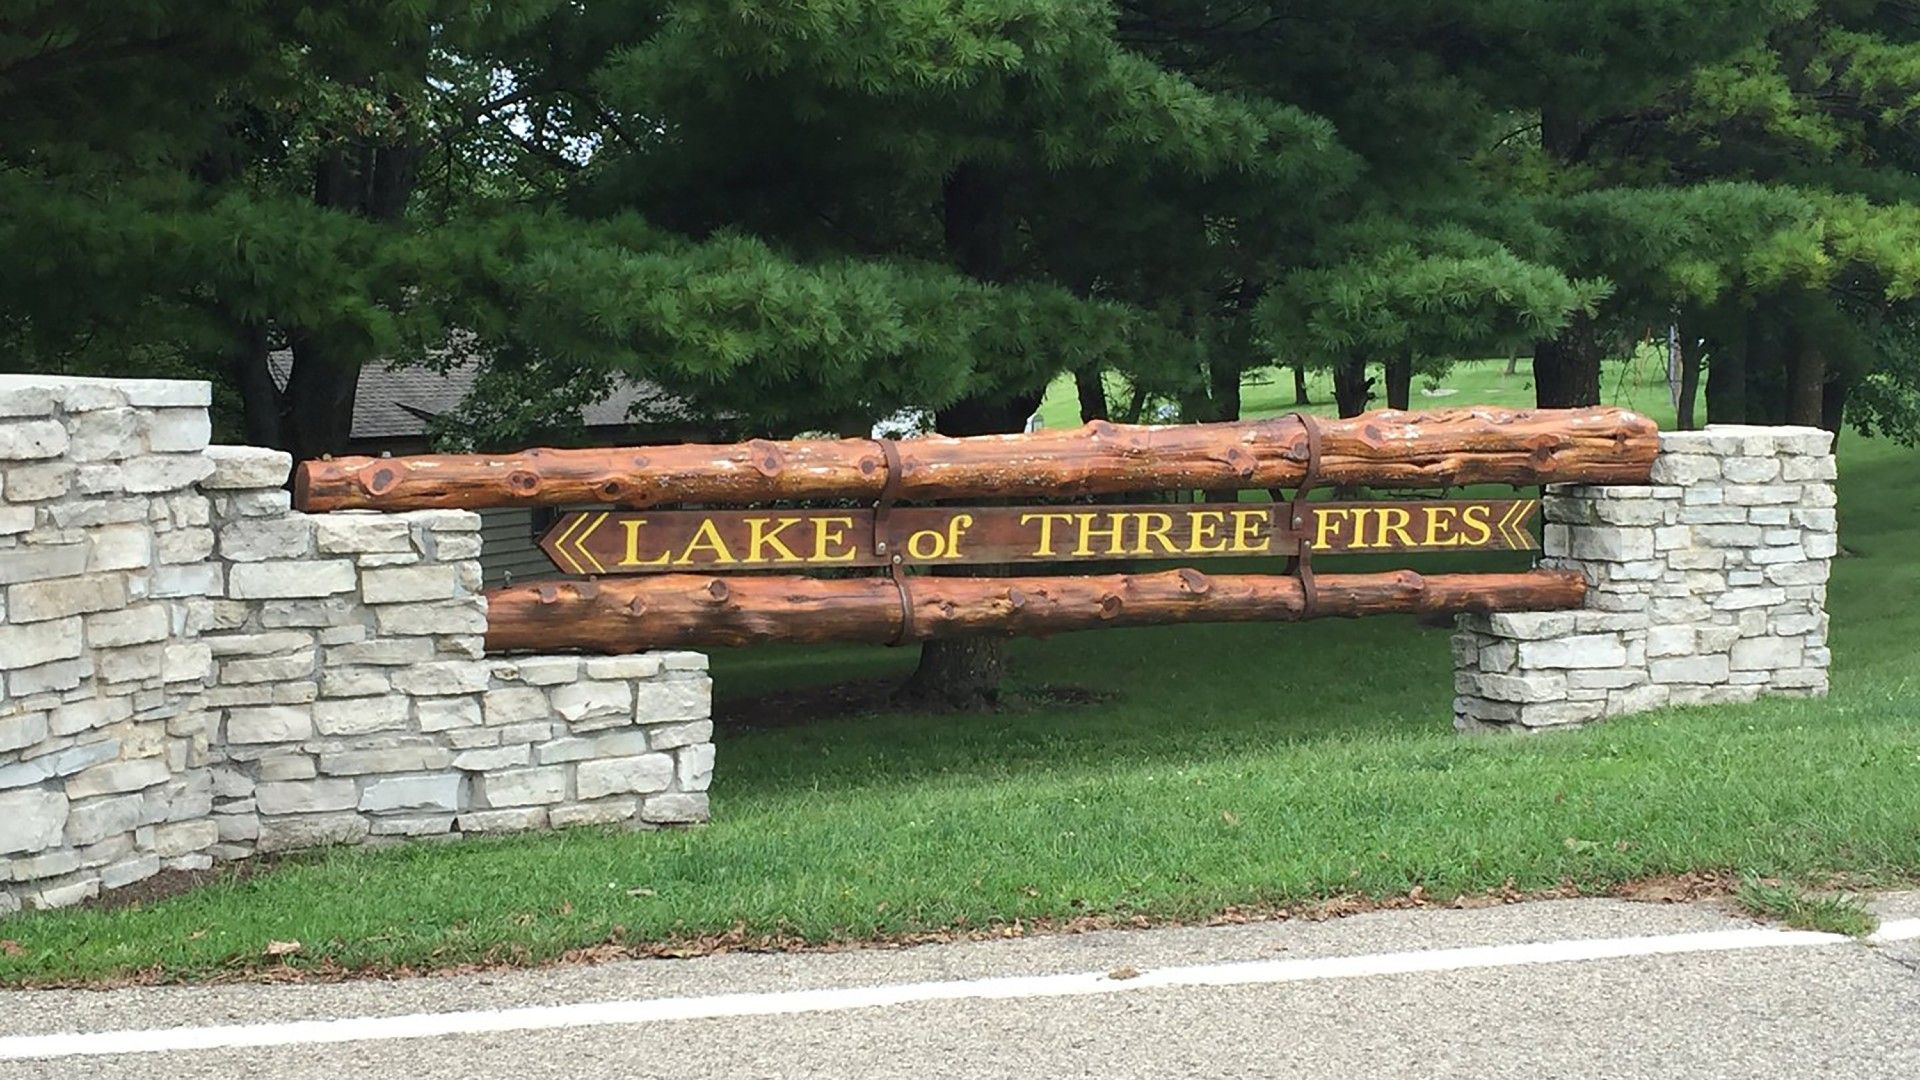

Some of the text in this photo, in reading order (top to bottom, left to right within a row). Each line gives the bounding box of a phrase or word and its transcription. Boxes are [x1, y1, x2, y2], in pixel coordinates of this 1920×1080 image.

[618, 505, 1491, 566] LAKE of THREE FIRES
